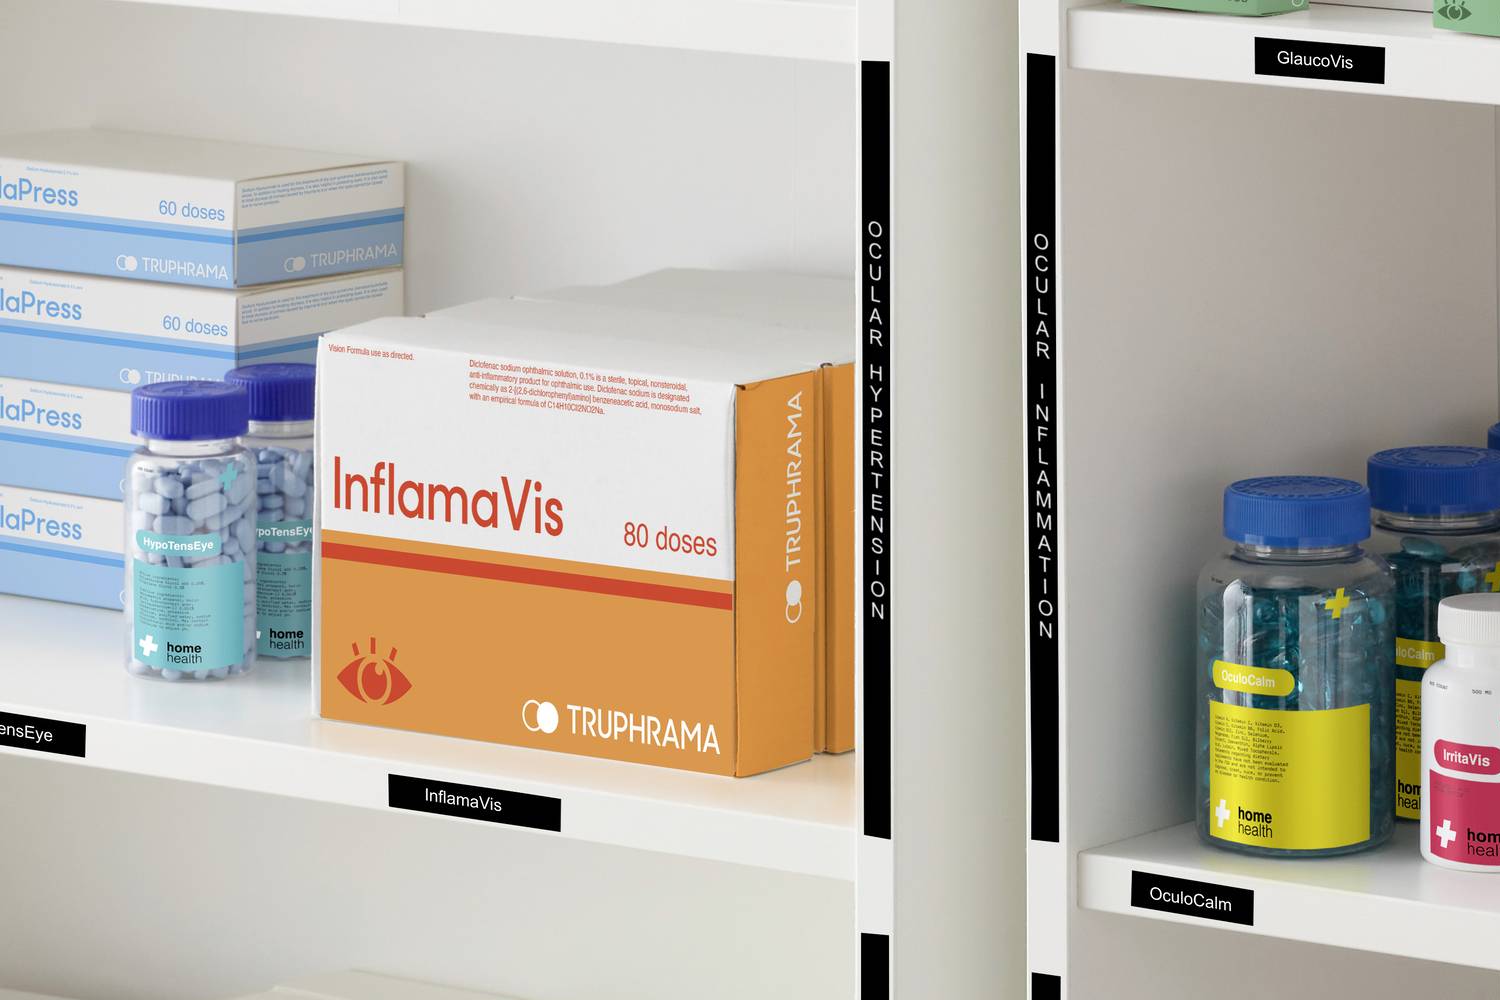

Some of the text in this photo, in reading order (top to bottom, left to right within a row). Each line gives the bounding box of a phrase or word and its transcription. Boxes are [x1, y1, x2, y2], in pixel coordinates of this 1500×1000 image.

[1276, 49, 1355, 71] GlaucoVis
[159, 200, 226, 222] 60 doses
[310, 243, 398, 268] TRUPHRAMA
[142, 256, 229, 281] TRUPHRAMA
[163, 316, 228, 337] 60 doses
[328, 343, 346, 353] Vision
[346, 346, 370, 356] Formula
[370, 349, 381, 358] use
[390, 350, 415, 361] directed.
[469, 359, 499, 370] Diclofenac
[500, 362, 521, 372] sodium
[522, 364, 553, 378] ophthalmic
[554, 368, 579, 380] solution,
[0, 396, 82, 430] laPress
[868, 220, 885, 620] OCULAR HYPERTENSION
[1033, 233, 1053, 639] OCULAR INFLAMMATION
[785, 390, 803, 573] TRUPHRAMA
[333, 455, 565, 538] InflamaVis
[0, 505, 82, 541] laPress
[143, 536, 214, 553] HypoTensEye
[622, 521, 718, 558] 80 doses
[269, 628, 304, 639] home
[269, 638, 305, 650] health
[166, 641, 202, 654] home
[166, 652, 203, 664] health
[1221, 669, 1276, 689] OculoCalm
[566, 703, 721, 756] TRUPHRAMA
[1443, 748, 1491, 768] IrritaVis
[424, 786, 503, 814] InflamaVis
[1237, 806, 1273, 824] home
[1237, 822, 1273, 839] health
[1149, 885, 1233, 912] OculoCalm
